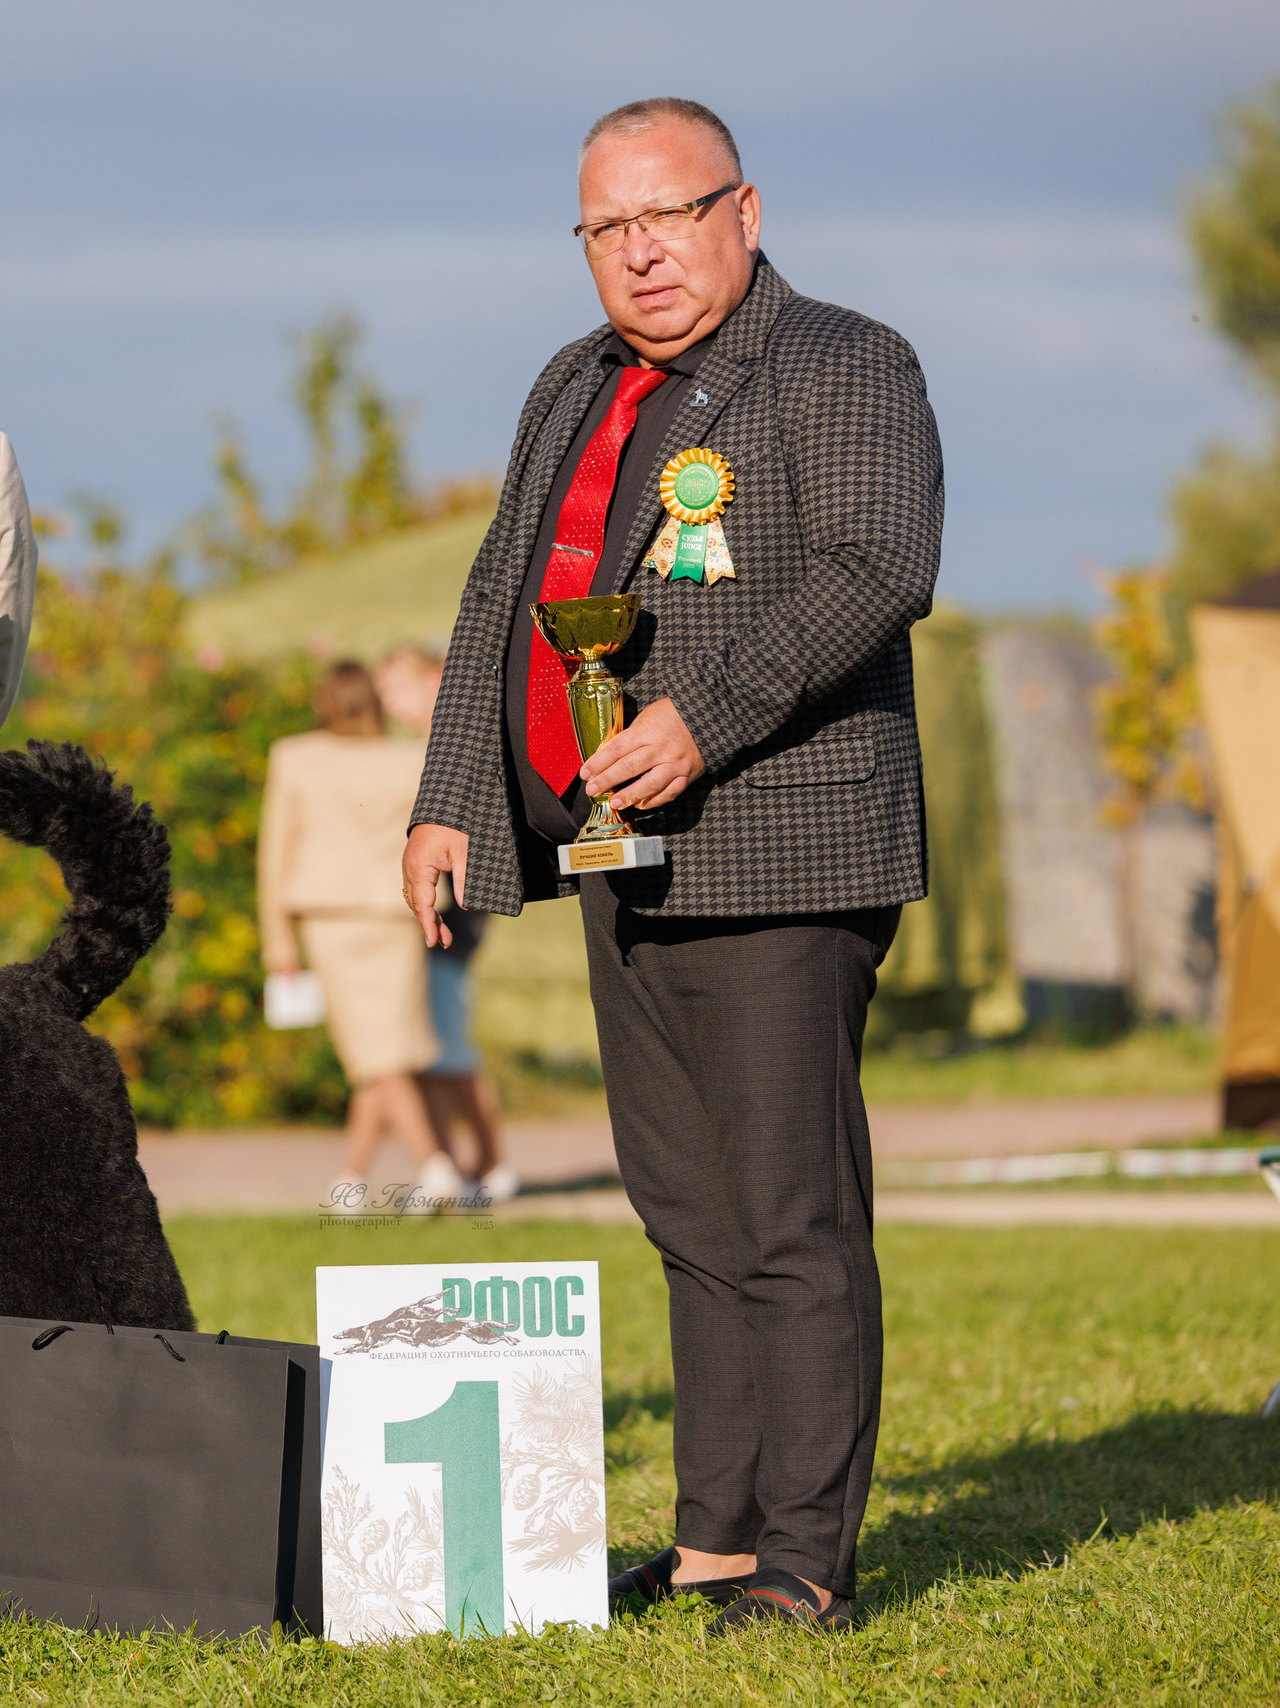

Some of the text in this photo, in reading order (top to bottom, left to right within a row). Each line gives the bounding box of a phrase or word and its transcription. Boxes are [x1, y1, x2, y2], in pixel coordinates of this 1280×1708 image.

[681, 534, 703, 542] СУДЬЯ
[681, 542, 702, 550] JUDGE
[442, 1275, 585, 1338] РФОС
[369, 1349, 586, 1360] ФЕДЕРАЦИЯ ОХОТНИЧЬЕГО СОБАКОВОДСТВА
[384, 1380, 505, 1640] 1
